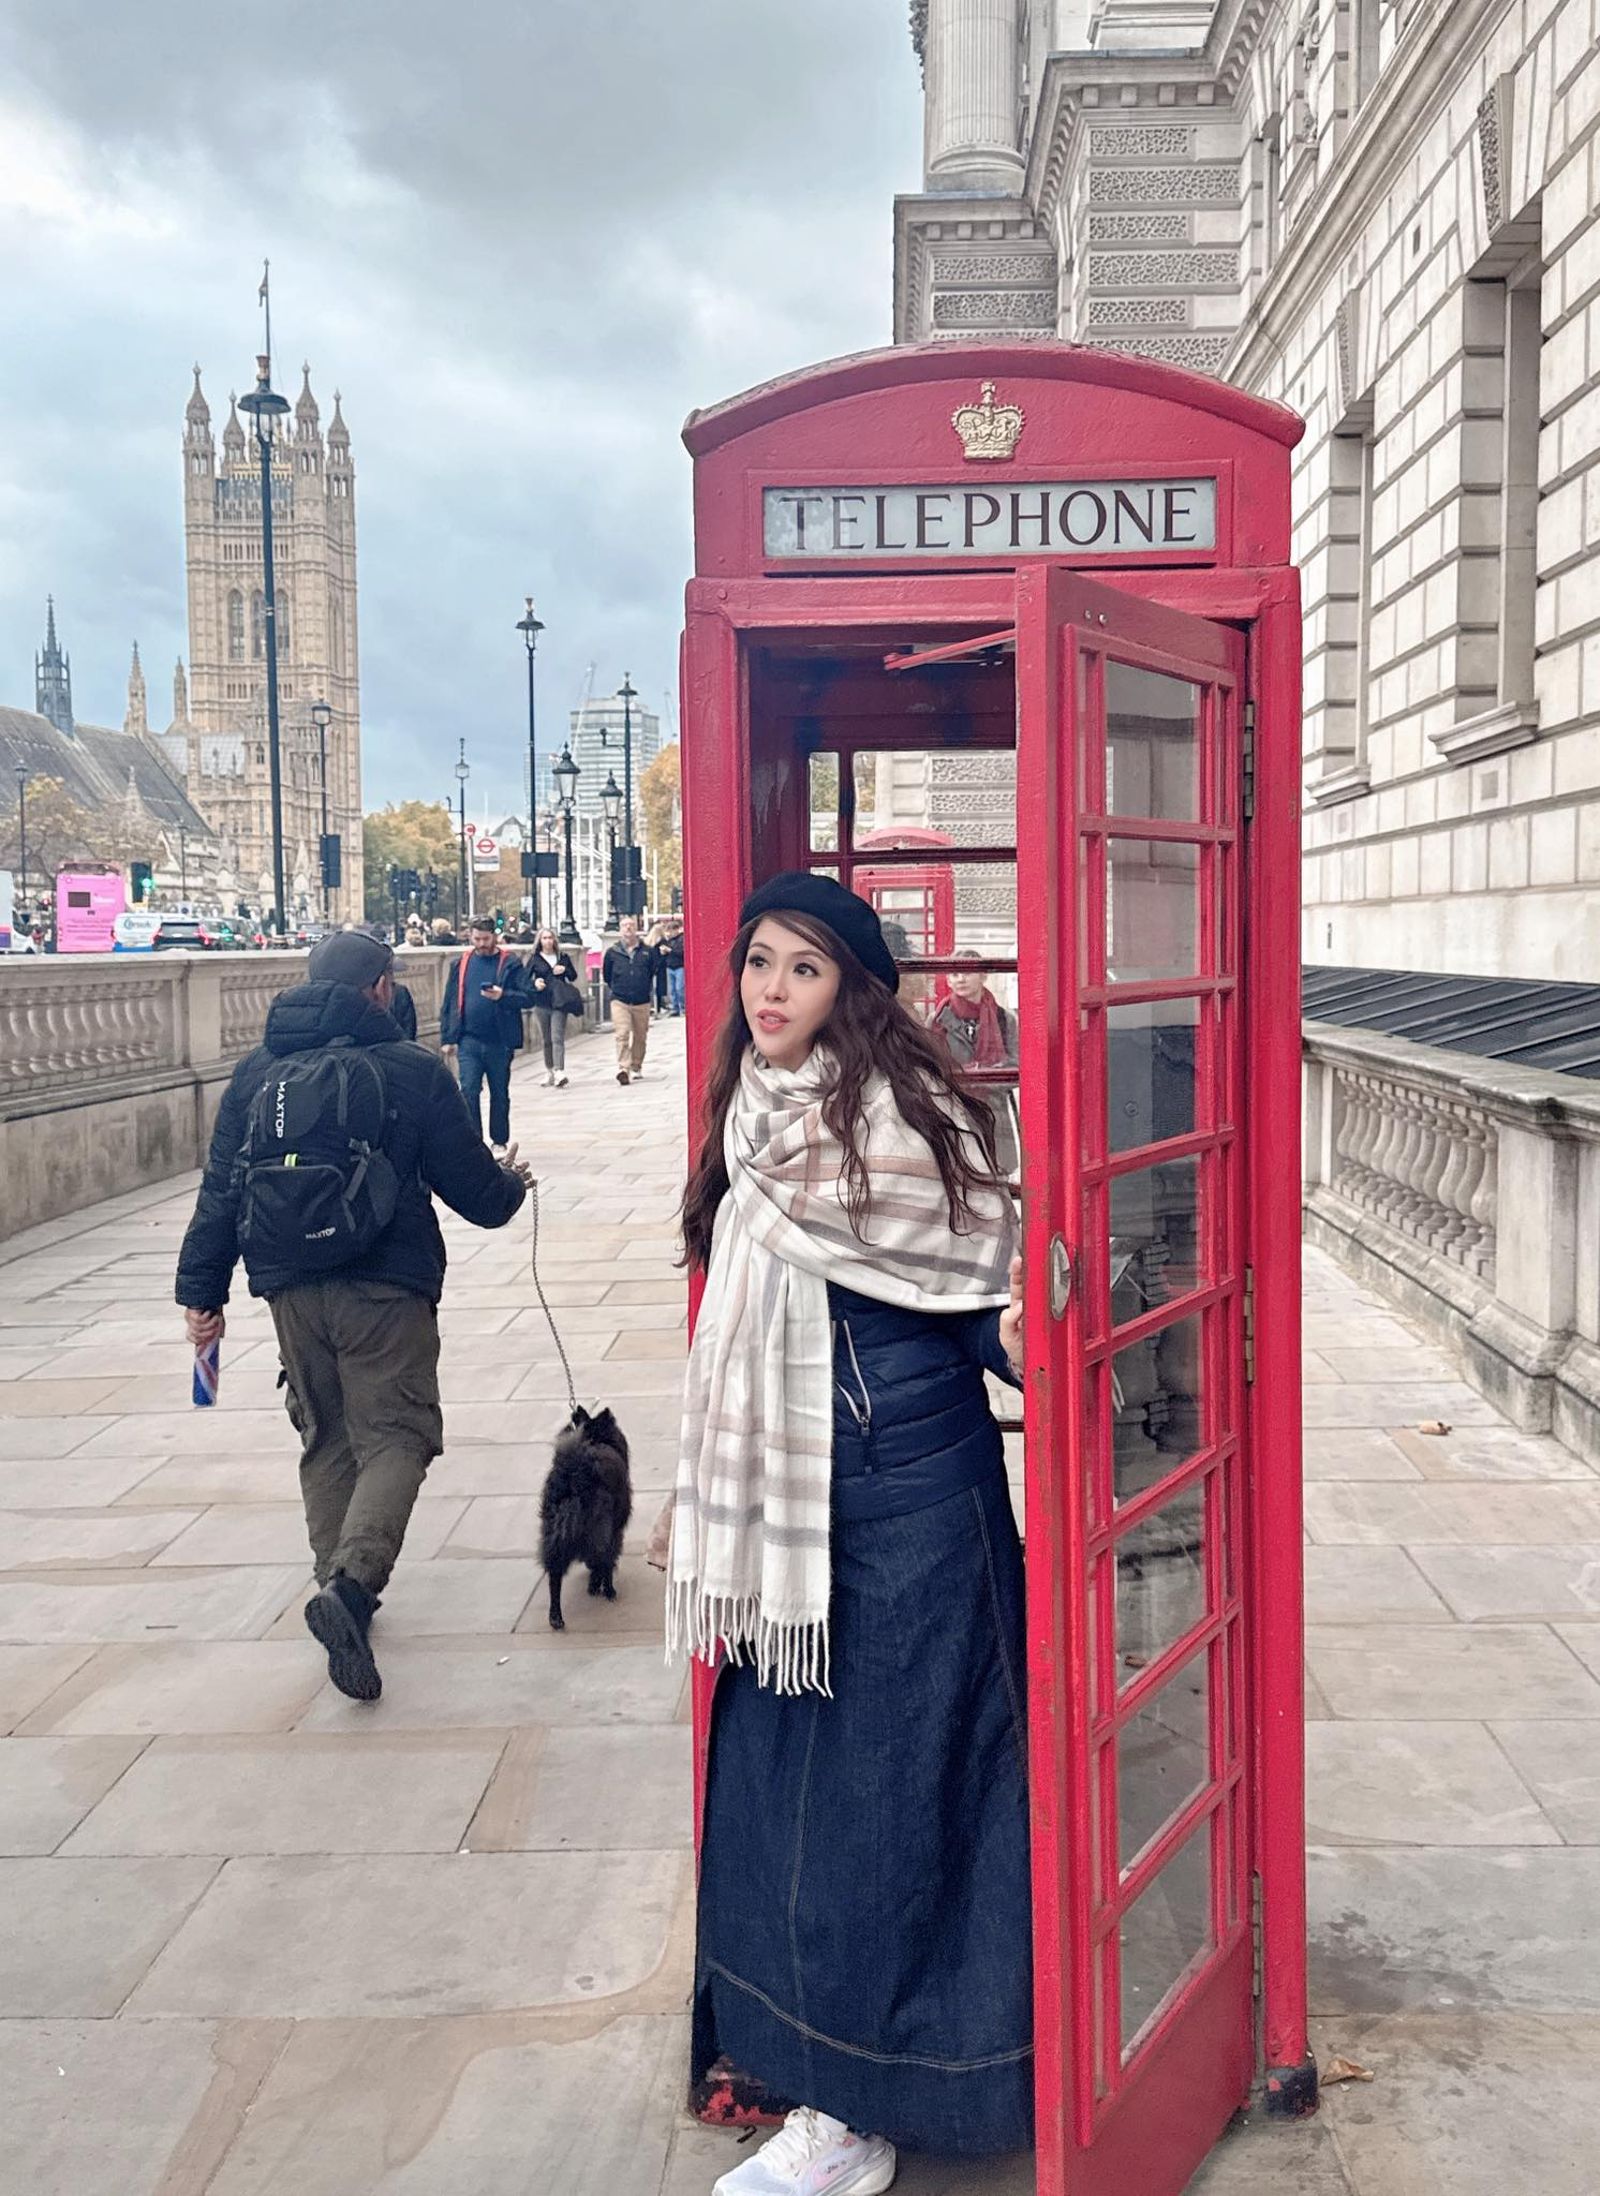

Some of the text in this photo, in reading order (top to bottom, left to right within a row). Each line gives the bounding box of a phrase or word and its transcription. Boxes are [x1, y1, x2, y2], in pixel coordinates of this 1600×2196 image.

[778, 486, 1198, 551] TELEPHONE
[275, 1081, 287, 1139] MAXTOP
[305, 1226, 336, 1240] MAXTOP
